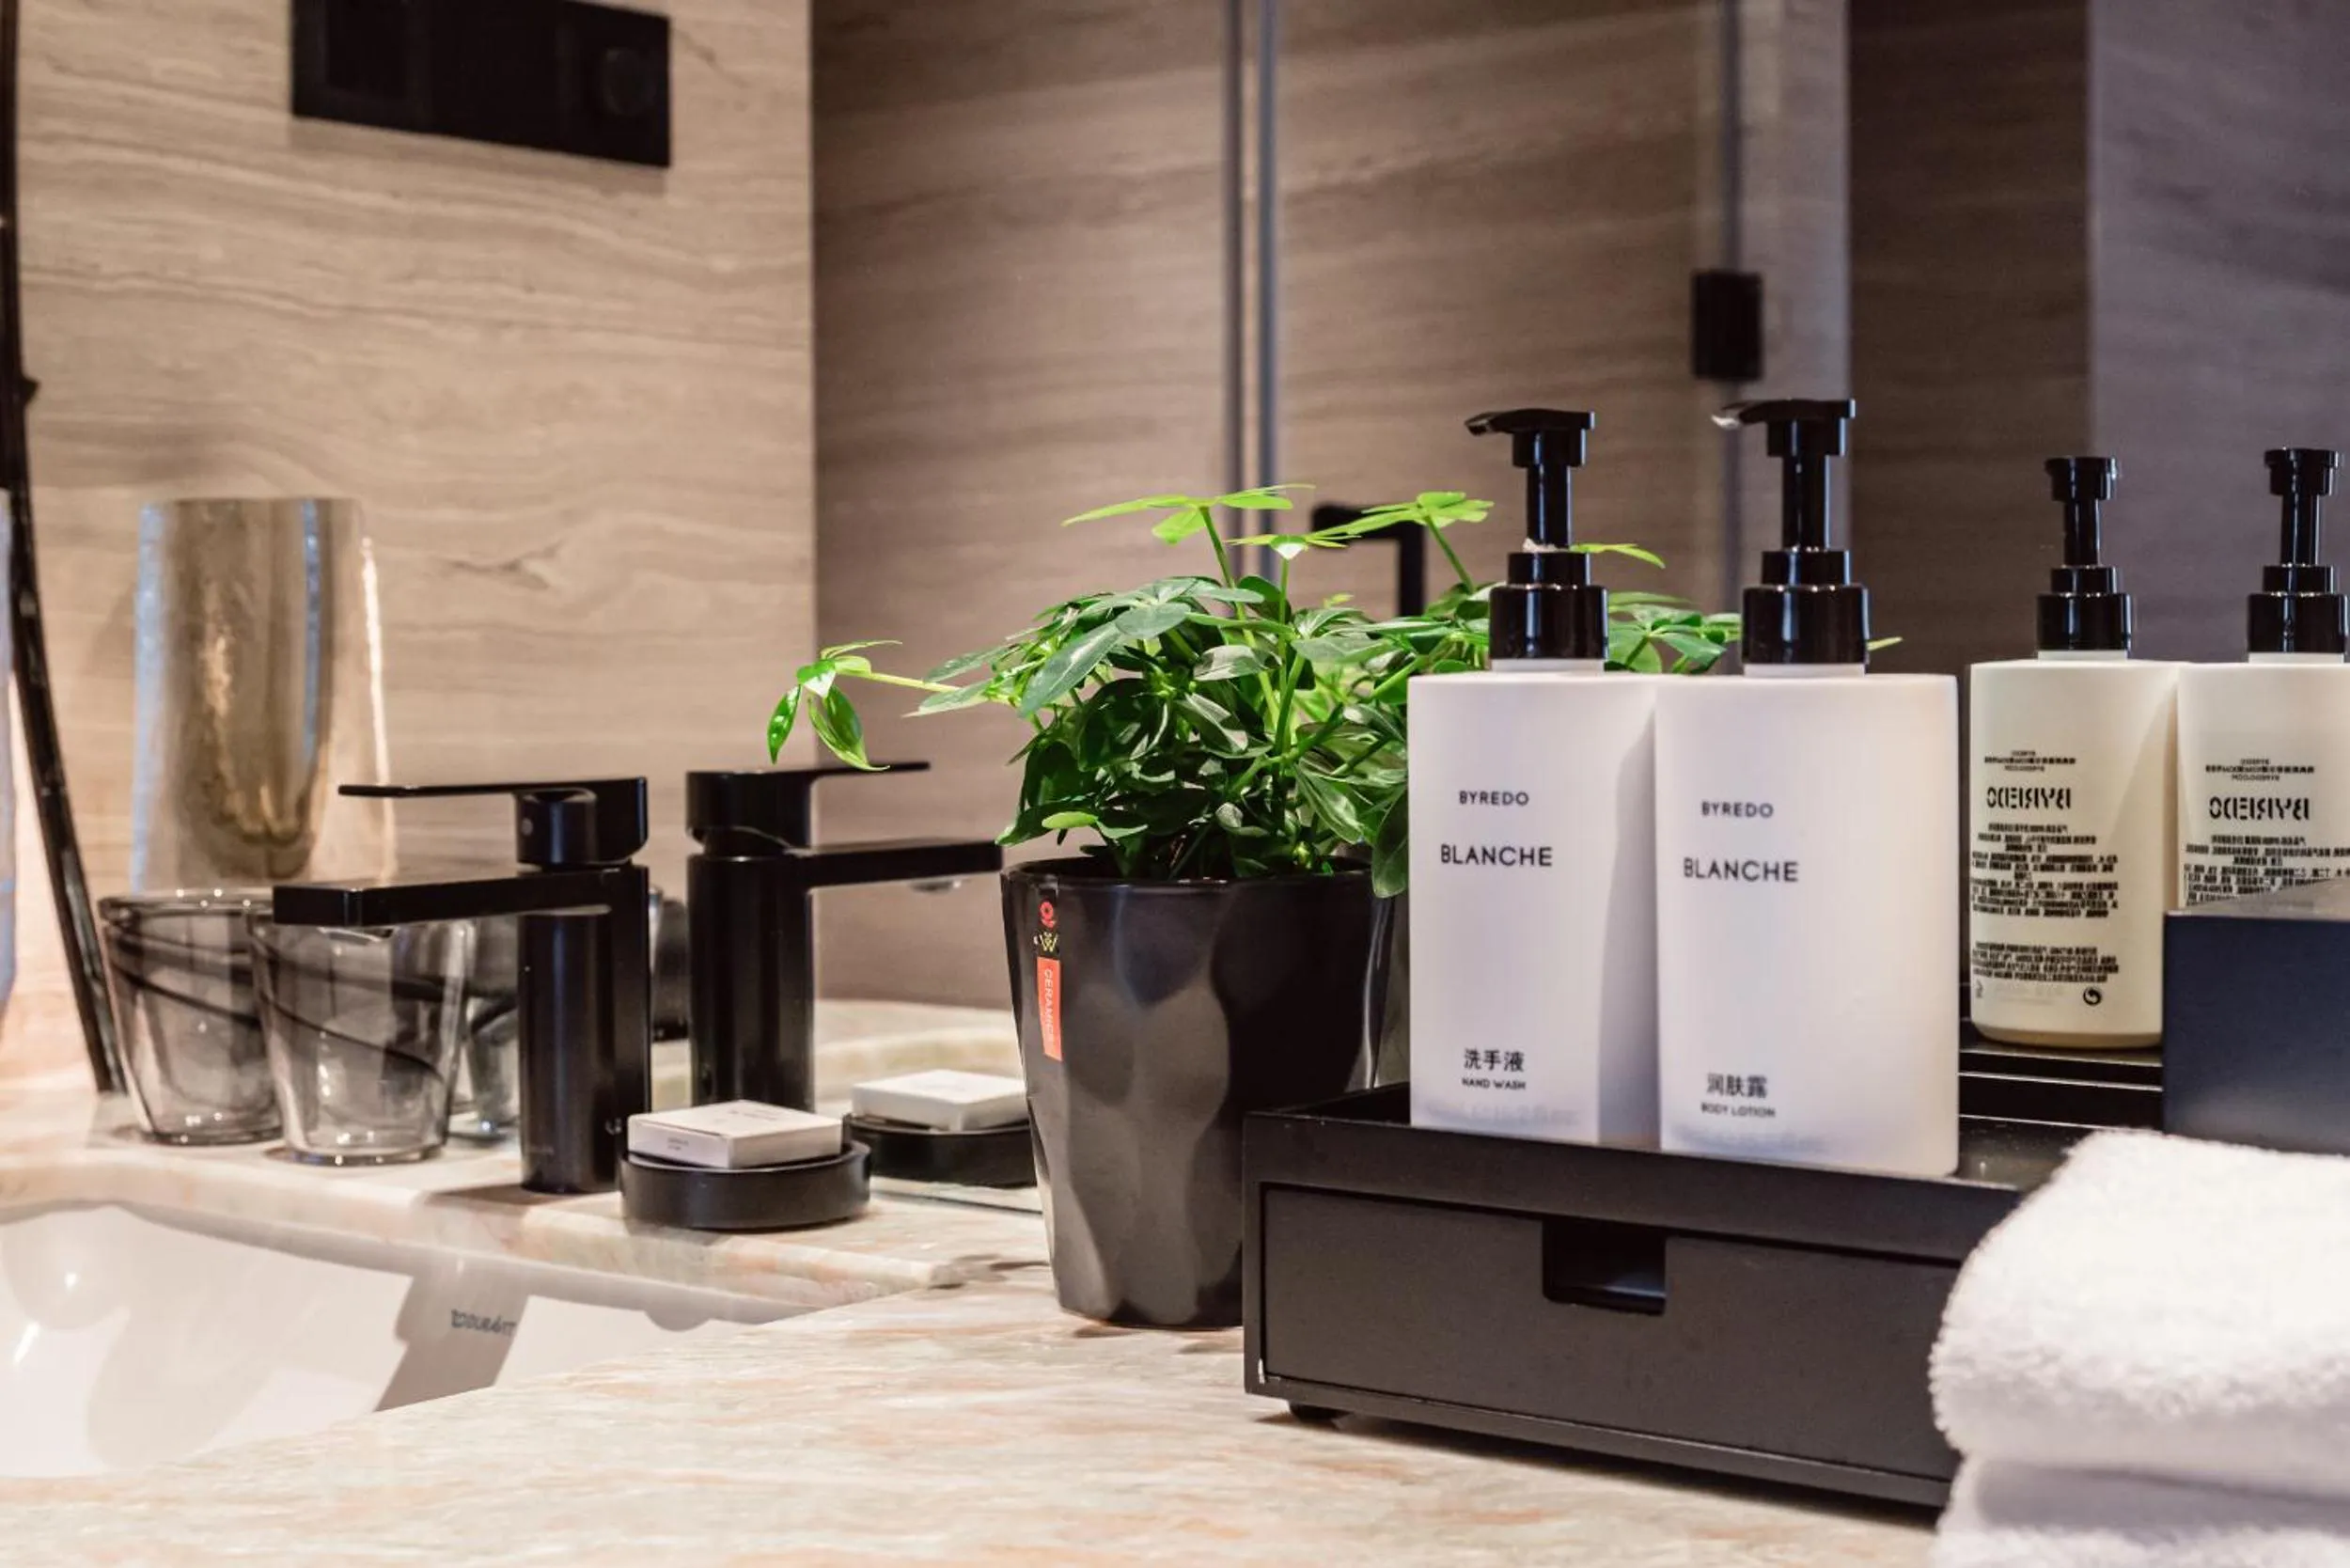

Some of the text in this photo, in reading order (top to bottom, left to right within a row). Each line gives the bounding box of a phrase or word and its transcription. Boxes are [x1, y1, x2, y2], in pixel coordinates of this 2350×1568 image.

[1459, 790, 1529, 807] BYREDO
[1701, 801, 1775, 819] BYREDO
[1440, 843, 1553, 868] BLANCHE
[1684, 857, 1799, 883] BLANCHE
[1464, 1047, 1525, 1073] 洗手液
[1462, 1077, 1527, 1090] HAND WASH
[1707, 1073, 1768, 1099] 润肤露
[1700, 1102, 1776, 1119] BODY LOTION
